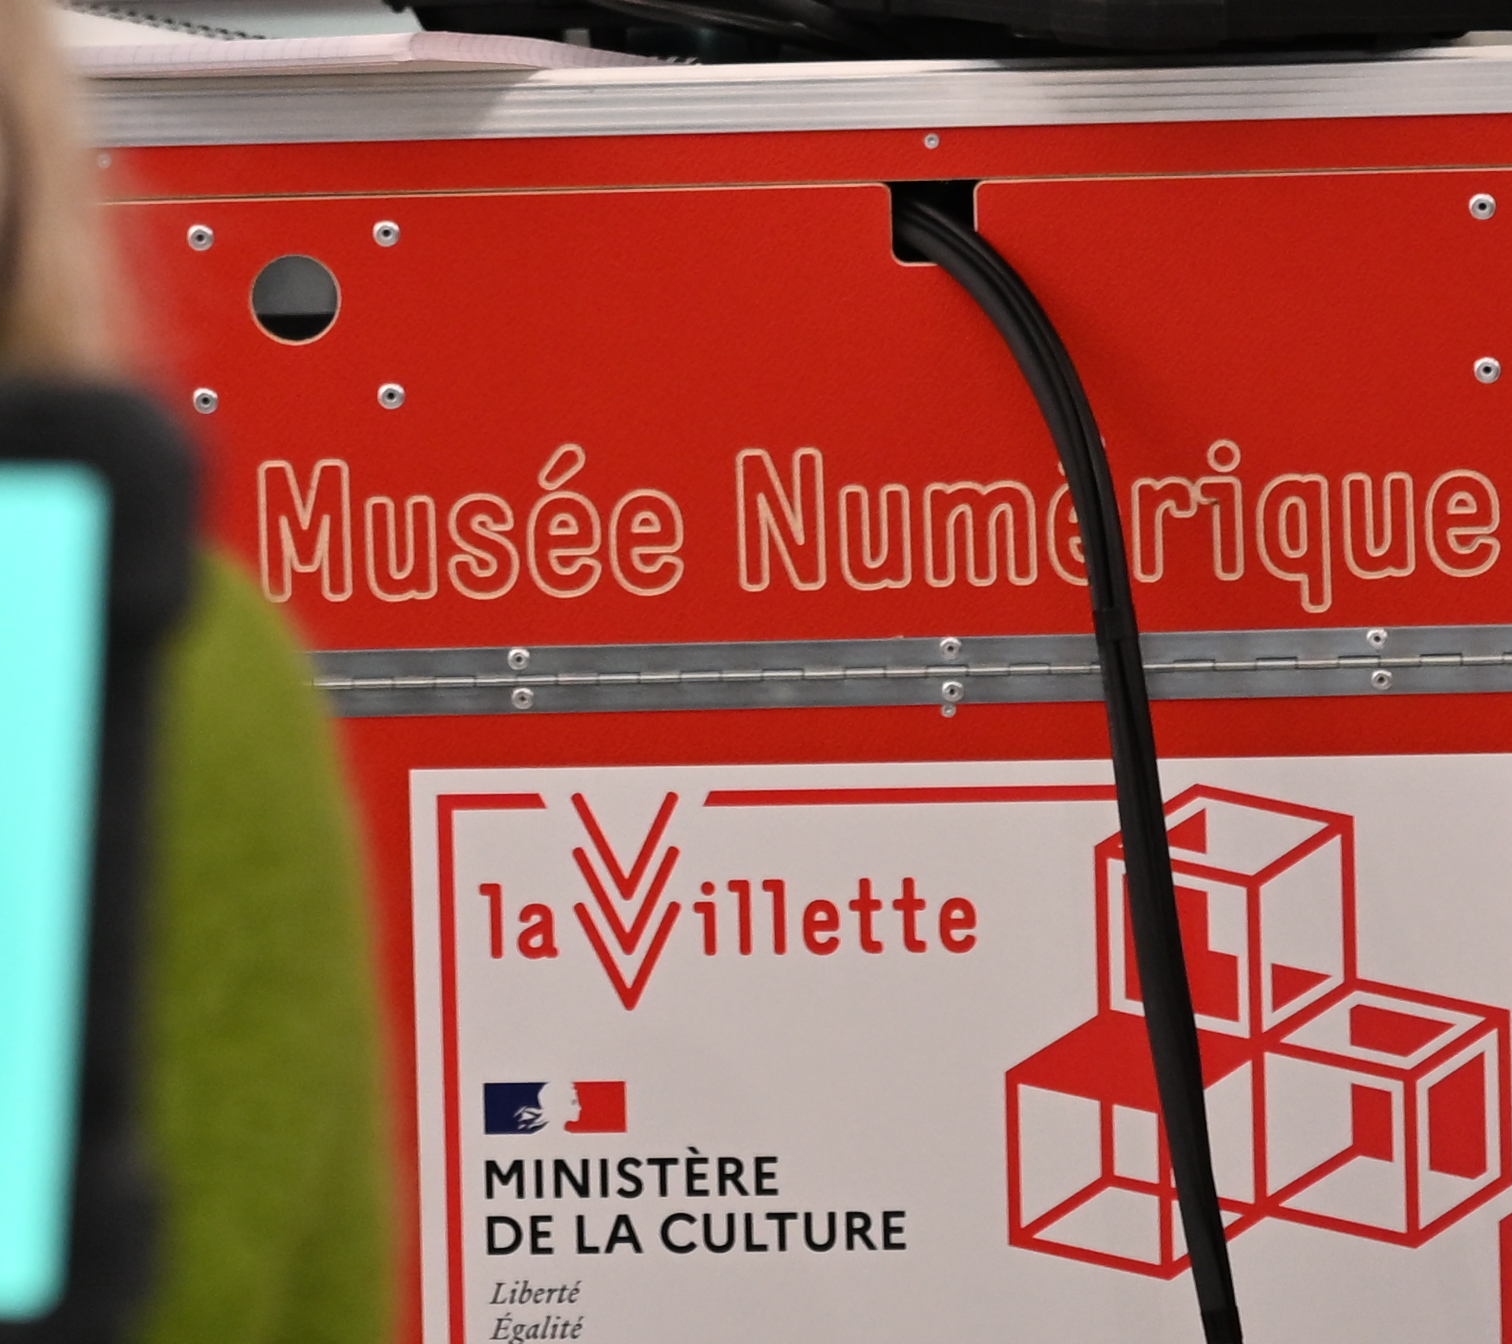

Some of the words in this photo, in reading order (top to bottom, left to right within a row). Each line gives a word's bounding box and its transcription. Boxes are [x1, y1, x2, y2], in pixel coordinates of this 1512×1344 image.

[256, 443, 684, 606] Musée
[484, 1146, 780, 1200] MINISTÈRE
[486, 1214, 555, 1256] DE
[575, 1213, 644, 1255] LA
[659, 1209, 908, 1255] CULTURE
[488, 1279, 583, 1306] Liberté
[488, 1311, 585, 1344] Égalité
